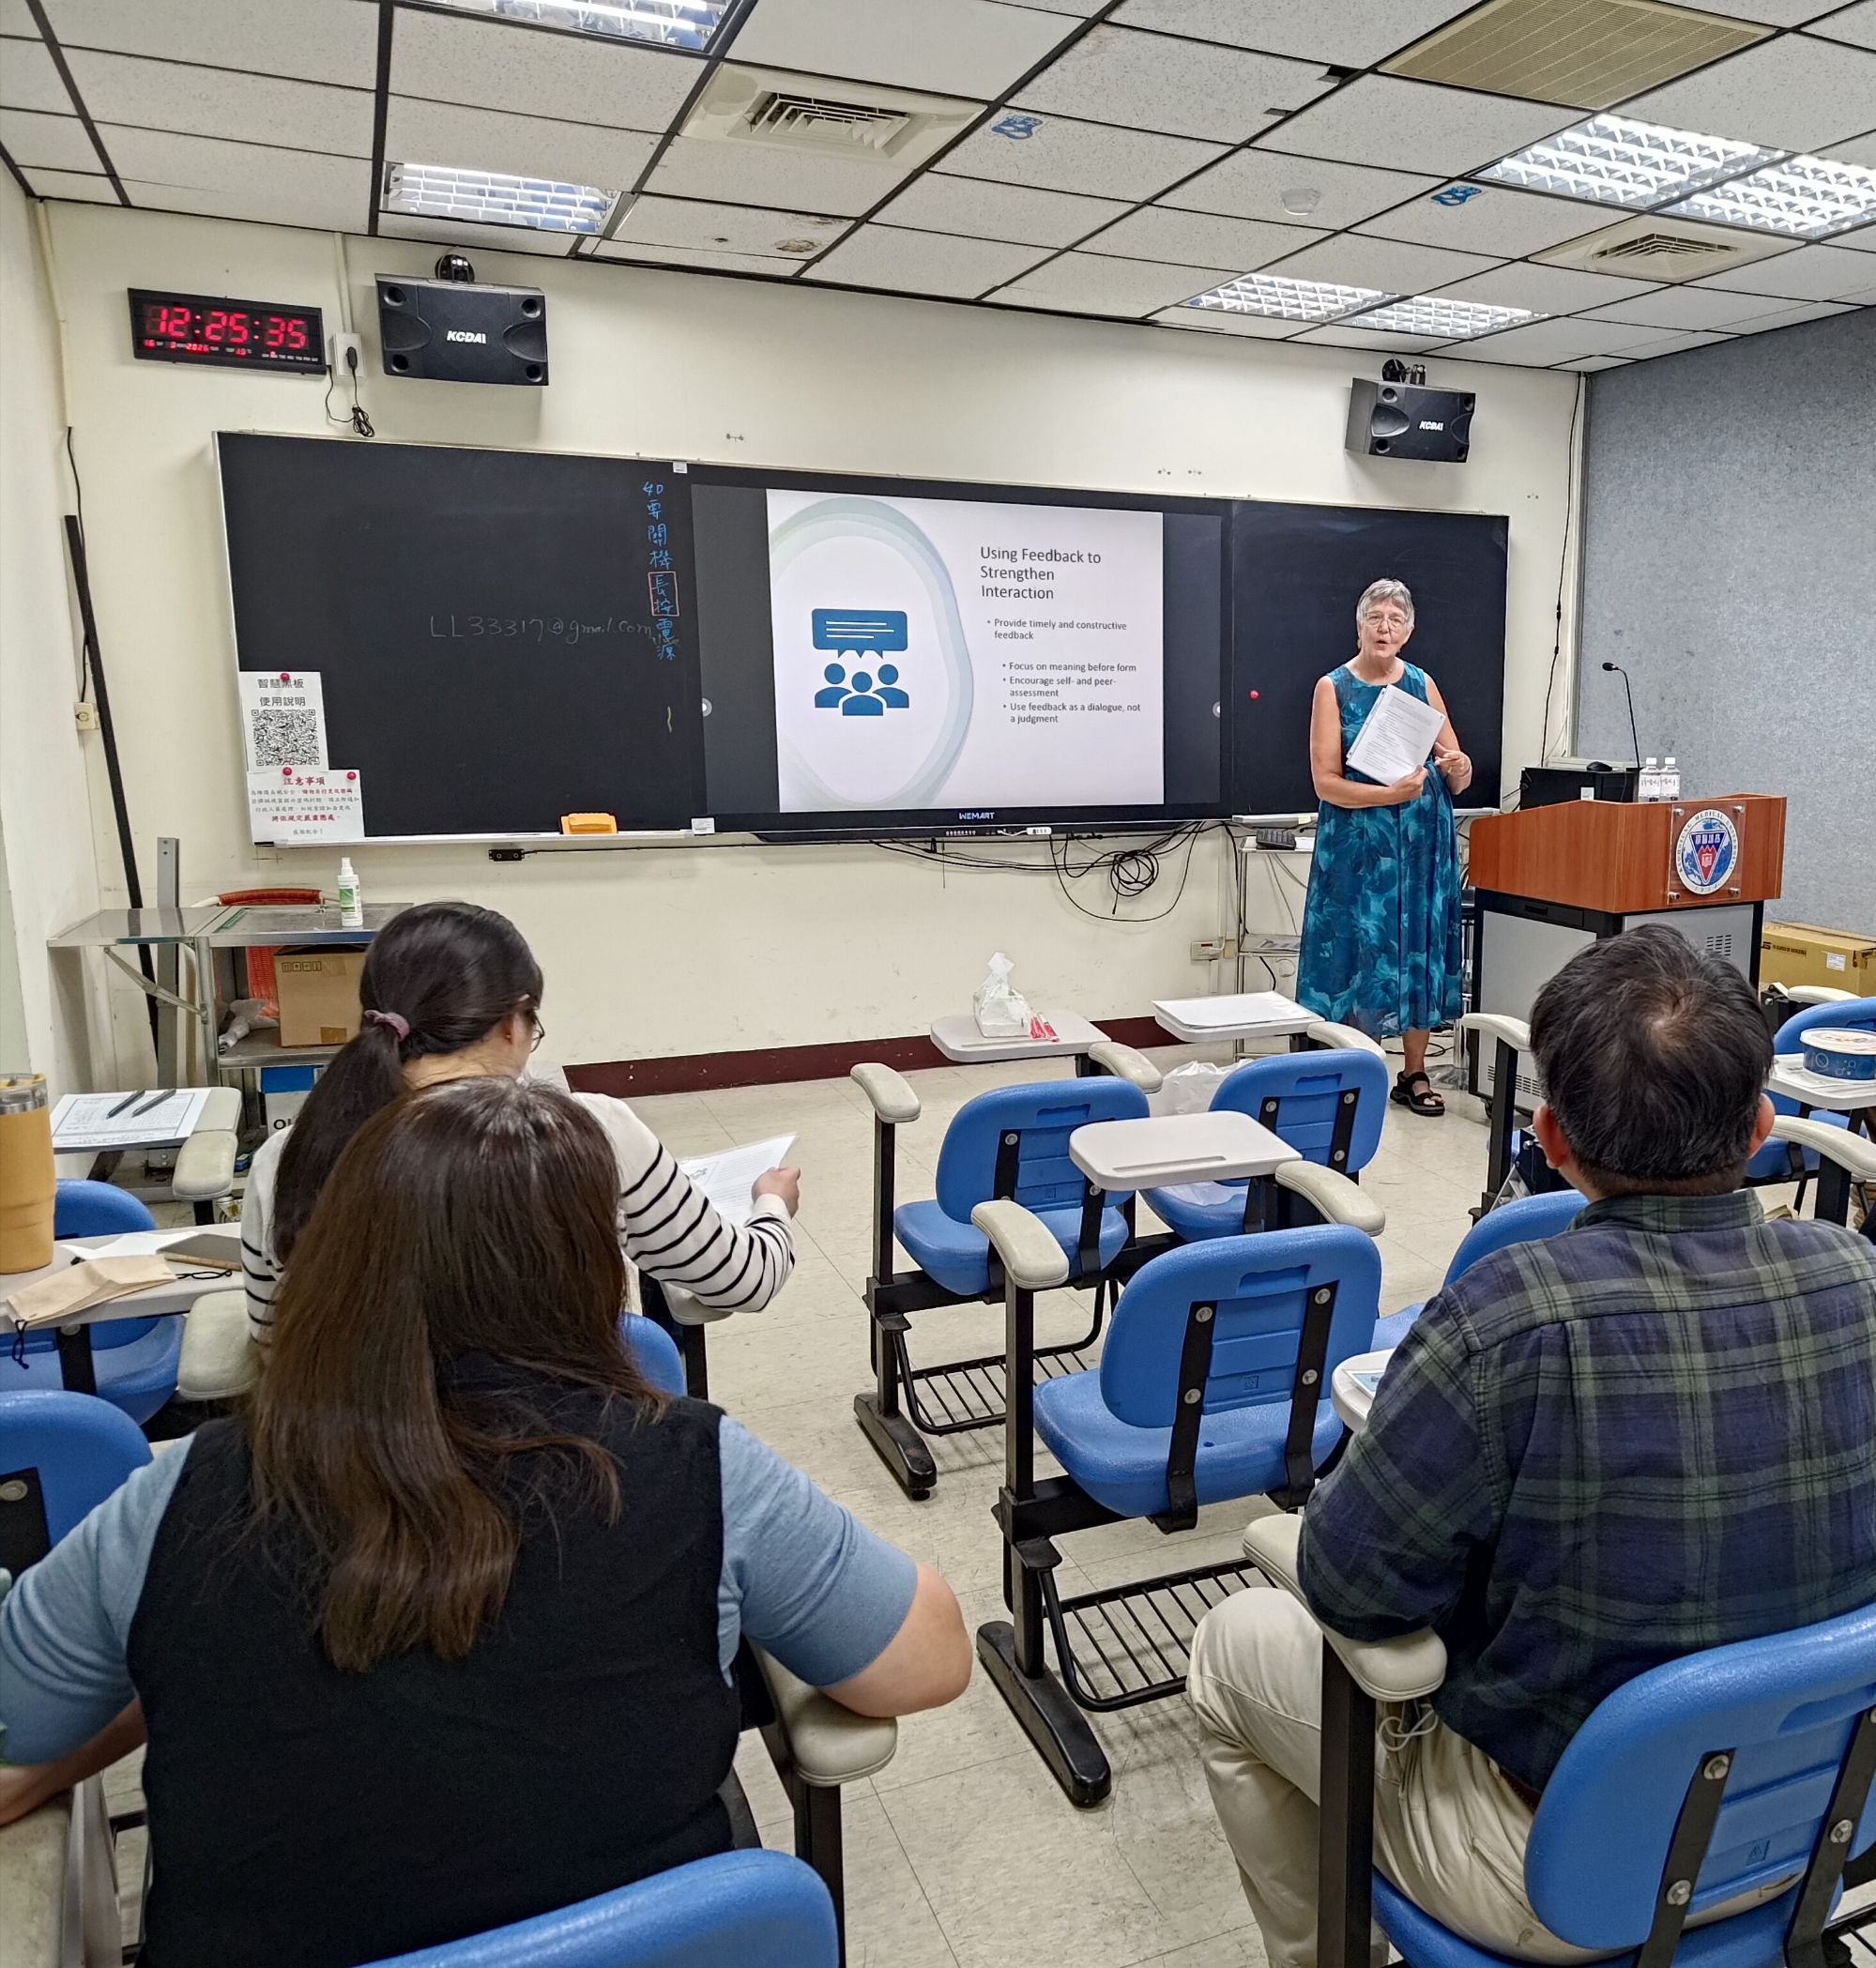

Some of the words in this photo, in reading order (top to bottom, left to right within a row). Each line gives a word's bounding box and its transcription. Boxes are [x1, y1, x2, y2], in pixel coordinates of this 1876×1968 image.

[159, 306, 307, 348] 12:25:35
[981, 546, 1017, 562] Using
[1022, 549, 1083, 562] Feedback
[1088, 553, 1101, 563] to
[981, 566, 1054, 582] Strengthen
[983, 586, 1053, 599] Interaction
[995, 618, 1027, 627] Provide
[1030, 620, 1056, 630] timely
[995, 631, 1033, 639] feedback
[1049, 664, 1086, 673] meaning
[1010, 677, 1054, 686] Encourage
[260, 696, 306, 707] 使用說明
[1029, 702, 1066, 710] feedback
[1088, 703, 1125, 712] dialogue,
[1017, 715, 1058, 725] judgment
[282, 776, 326, 786] 注意事項
[958, 812, 996, 820] WEMART
